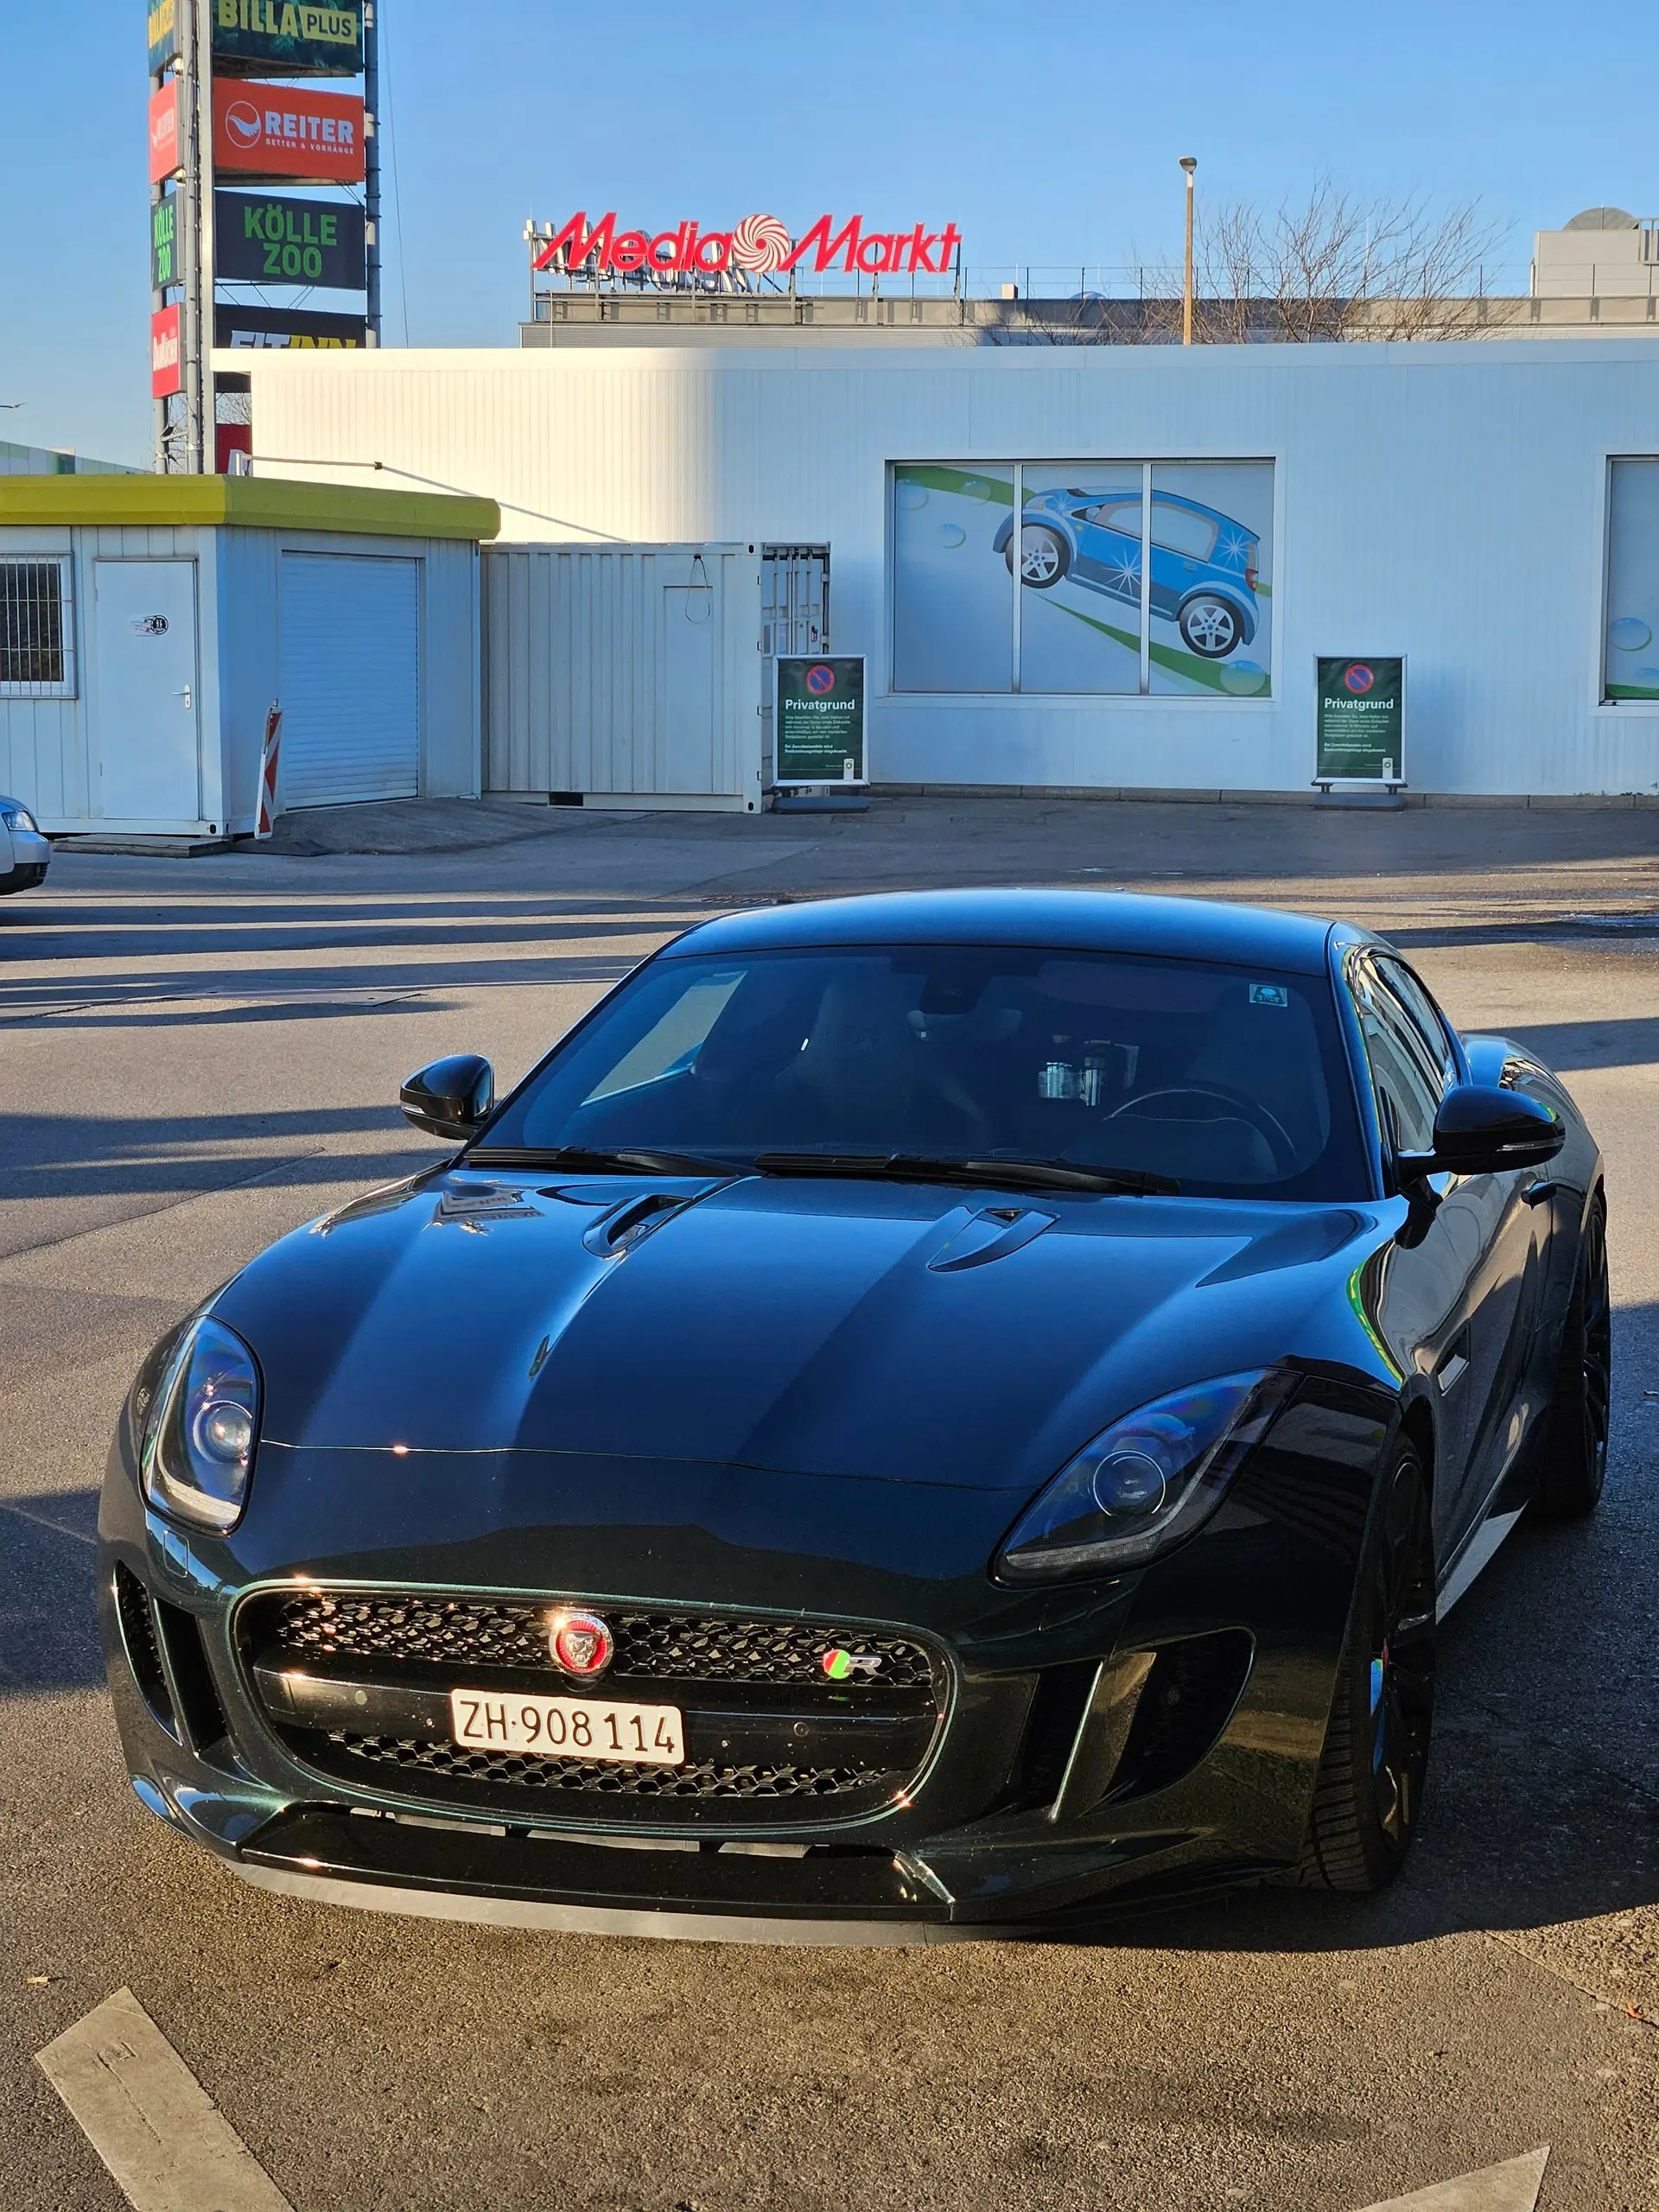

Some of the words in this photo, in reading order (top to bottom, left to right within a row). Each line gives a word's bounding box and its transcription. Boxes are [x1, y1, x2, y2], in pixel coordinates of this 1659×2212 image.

[219, 0, 299, 37] BILLA
[307, 13, 352, 35] PLUS
[264, 110, 353, 144] REITER
[265, 138, 296, 149] BETTEN
[244, 203, 338, 246] KÖLLE
[531, 211, 734, 272] Media
[778, 214, 963, 273] Markt
[158, 244, 171, 283] ZOO
[263, 242, 322, 278] ZOO
[785, 698, 855, 713] Privatgrund
[1324, 697, 1394, 711] Privatgrund
